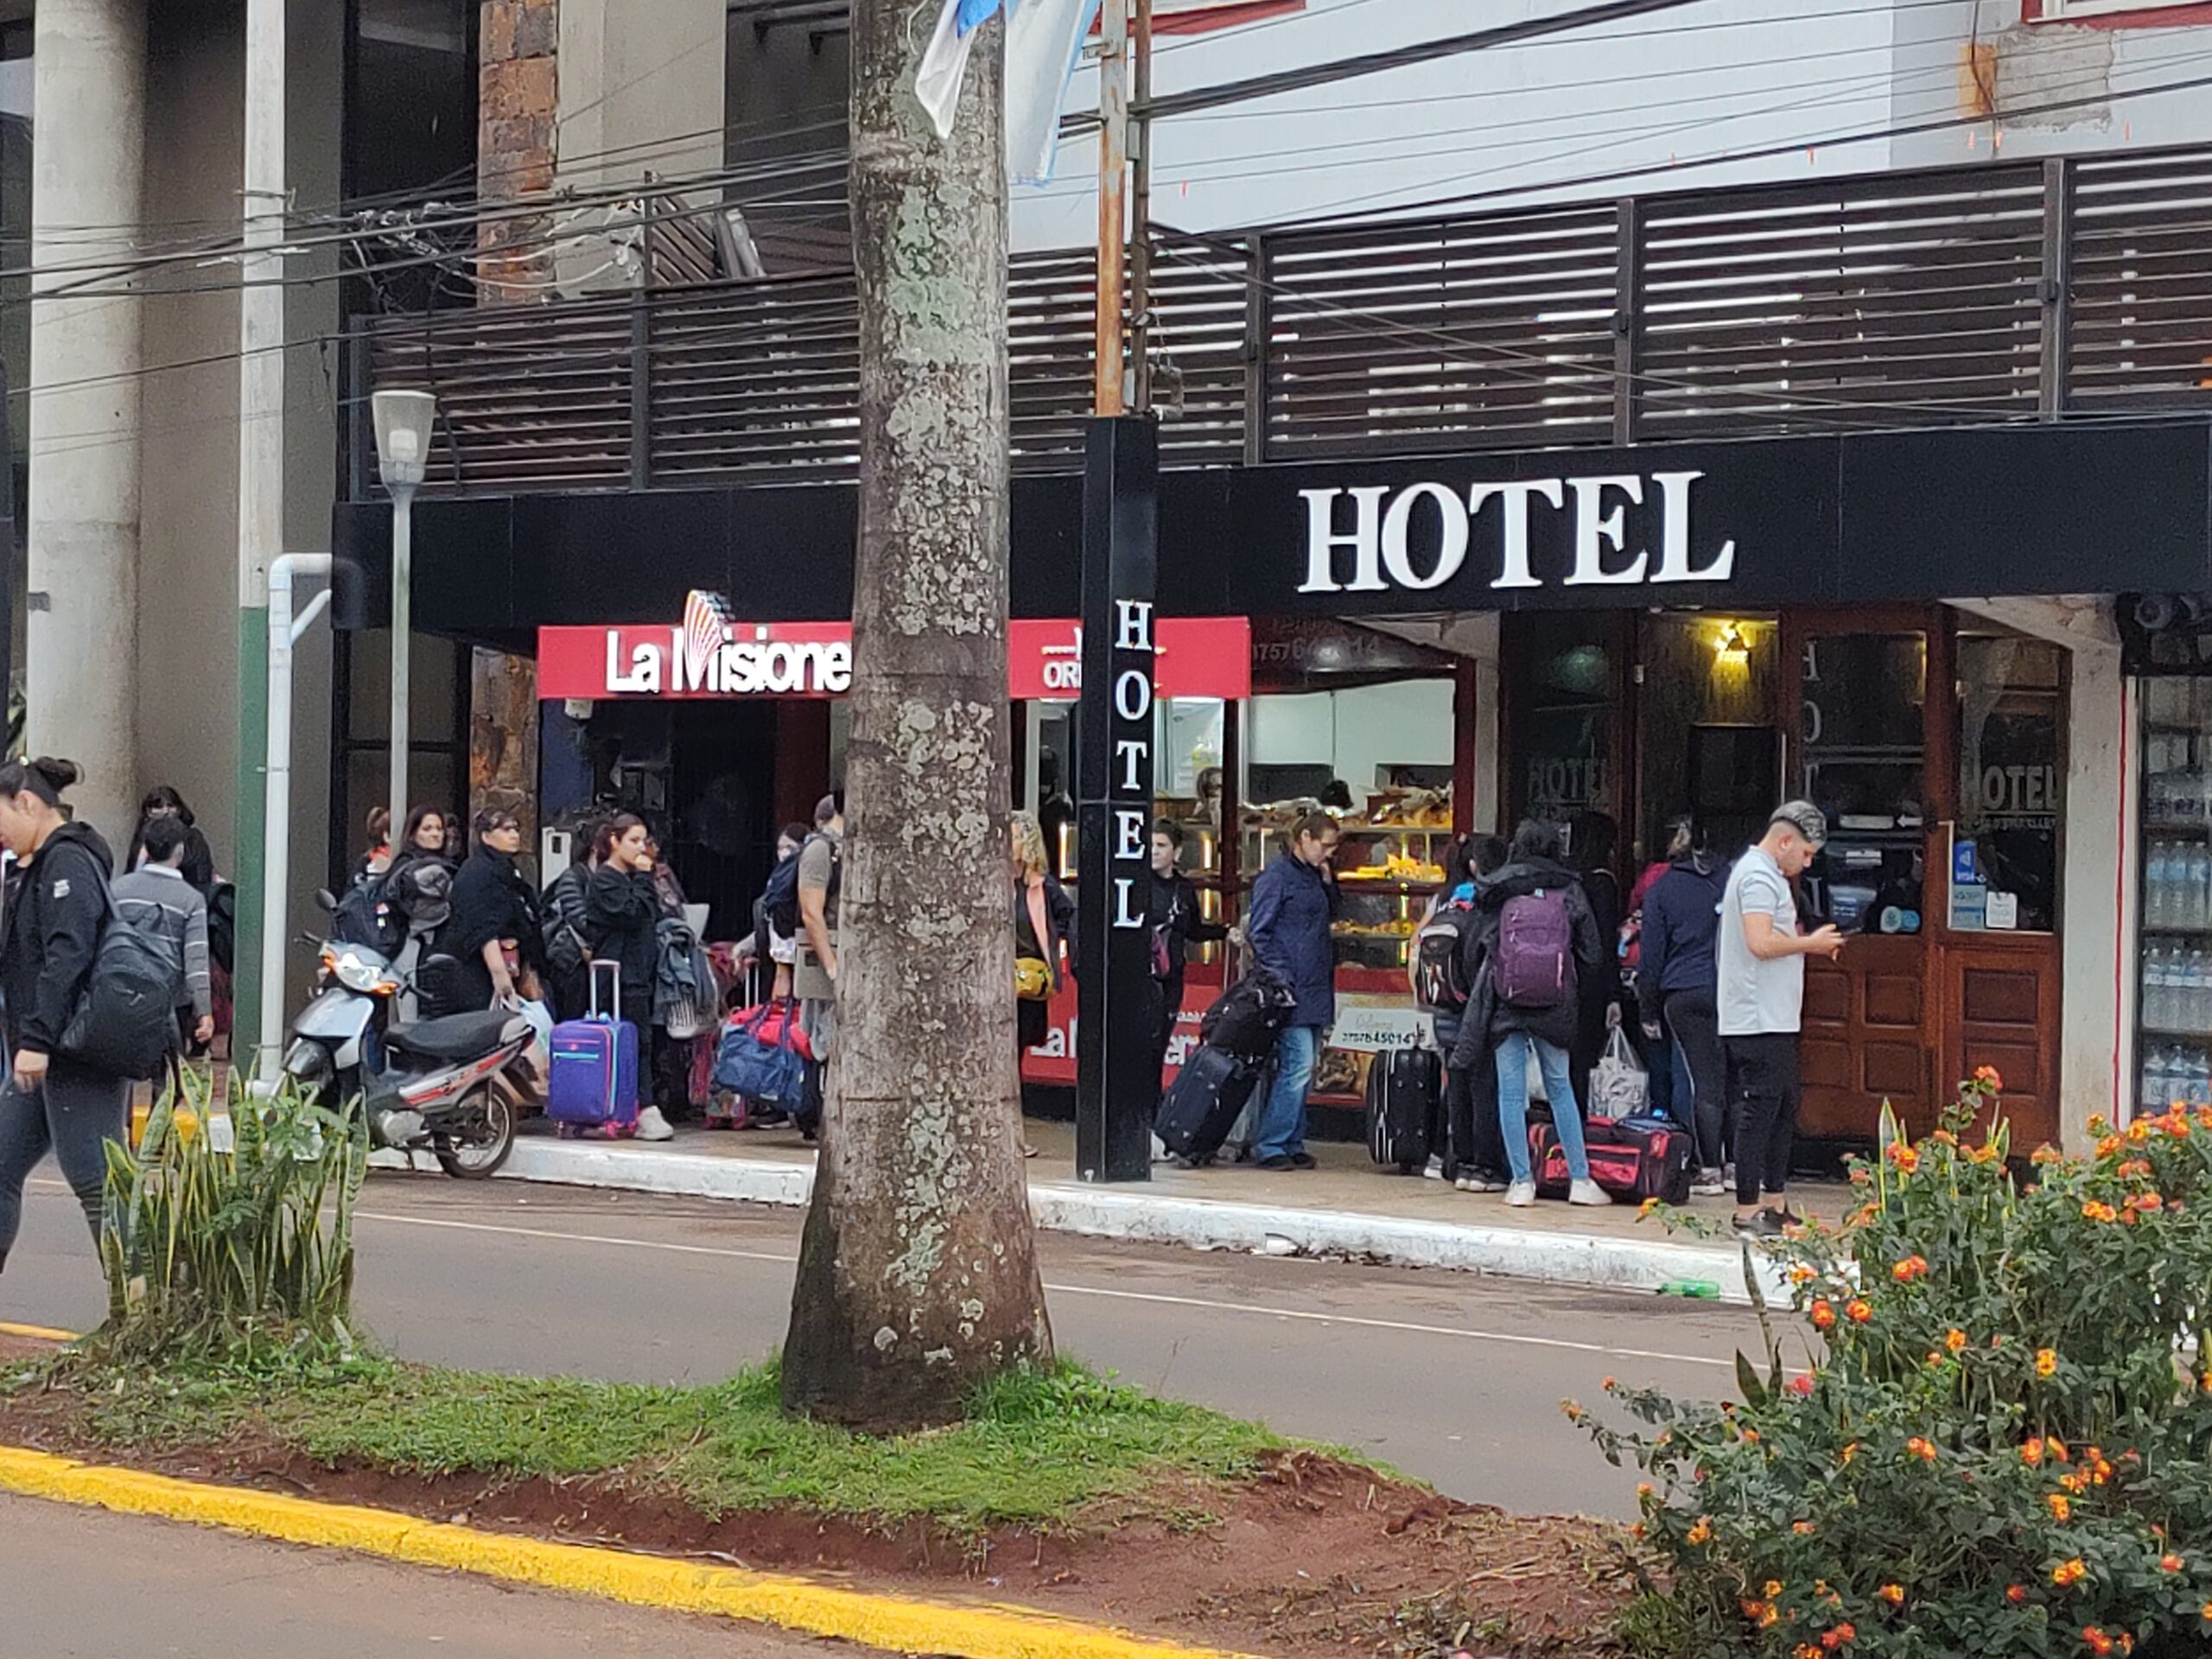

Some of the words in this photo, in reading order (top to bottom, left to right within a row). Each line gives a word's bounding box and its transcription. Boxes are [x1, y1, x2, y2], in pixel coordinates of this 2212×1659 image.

[1297, 470, 1735, 593] HOTEL
[607, 630, 660, 693] La
[1114, 599, 1153, 928] HOTEL
